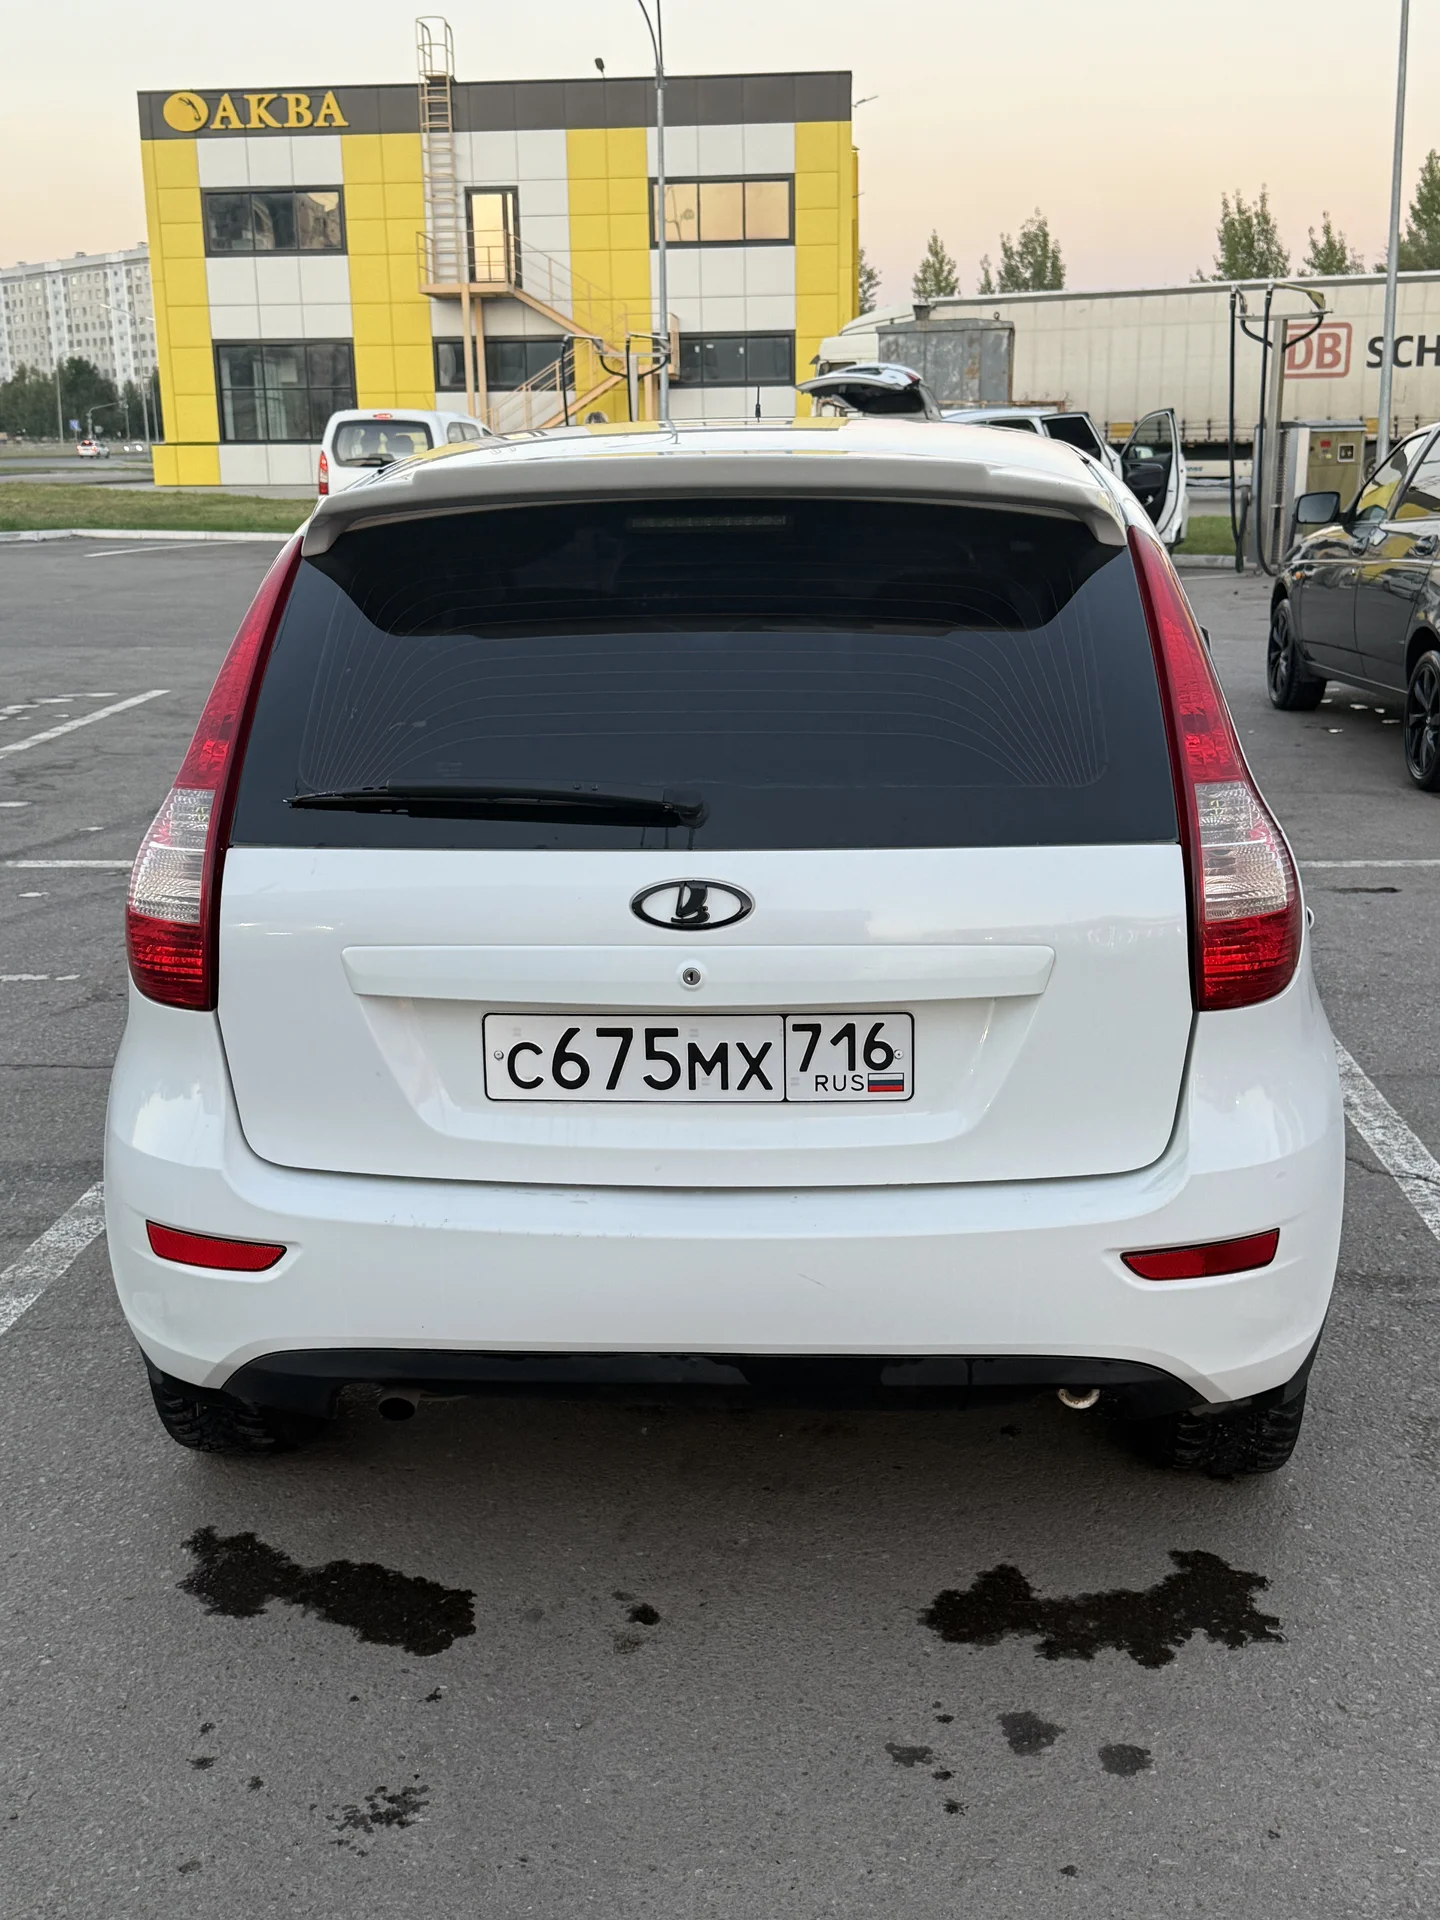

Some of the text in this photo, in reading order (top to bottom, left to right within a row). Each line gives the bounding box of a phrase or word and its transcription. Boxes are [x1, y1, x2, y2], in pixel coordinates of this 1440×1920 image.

[210, 90, 349, 129] АКВА
[1287, 332, 1342, 370] DB
[507, 1022, 894, 1091] С675МХ 716
[814, 1074, 865, 1091] RUS
